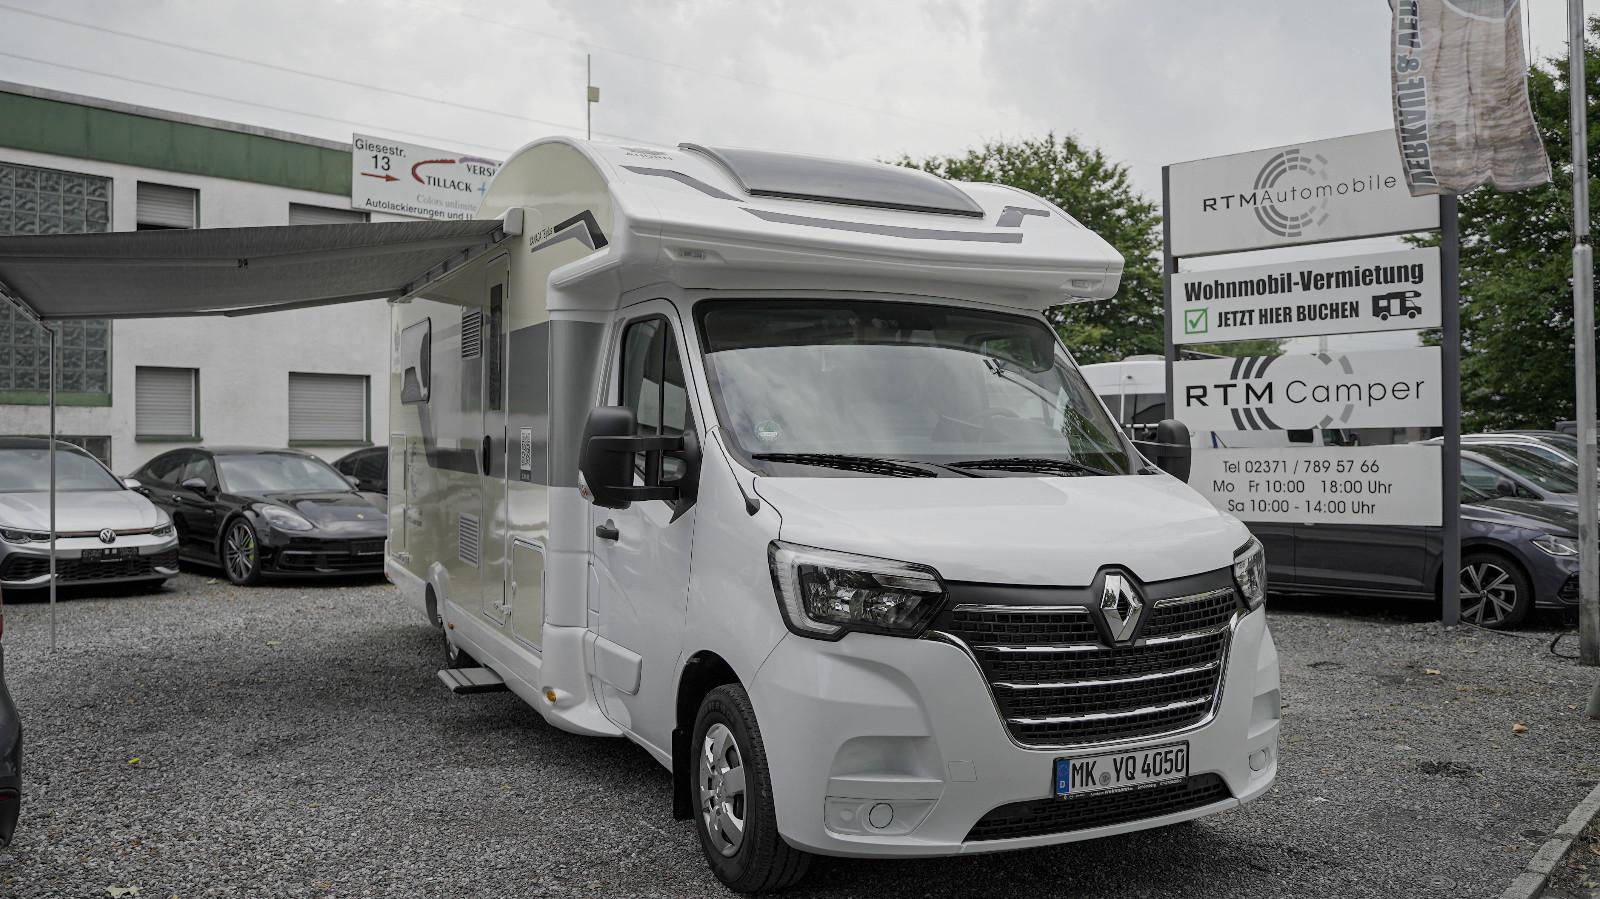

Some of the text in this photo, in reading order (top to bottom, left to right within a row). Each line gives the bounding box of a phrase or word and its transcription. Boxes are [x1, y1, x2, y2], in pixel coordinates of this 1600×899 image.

[355, 138, 406, 158] Giesestr.
[371, 154, 391, 171] 13
[425, 175, 472, 193] TILLACK
[365, 198, 445, 219] Autolackierungen
[447, 208, 464, 220] und
[1184, 263, 1424, 302] Wohnmobil-Vermietung
[1217, 301, 1359, 328] JETZT HIER BUCHEN
[1186, 380, 1425, 407] RTM Camper
[1223, 460, 1240, 473] Tel
[1245, 460, 1288, 473] 02371
[1304, 460, 1331, 473] 789
[1336, 460, 1354, 473] 57
[1360, 460, 1380, 473] 66
[1213, 480, 1393, 494] Mo Fr 10:00 18:00 Uhr
[1228, 500, 1244, 513] Sa
[1251, 500, 1289, 513] 10:00
[1305, 500, 1346, 514] 14:00
[1352, 500, 1376, 514] Uhr
[1072, 760, 1097, 788] MK
[1113, 755, 1136, 782] YQ
[1141, 749, 1185, 777] 4050
